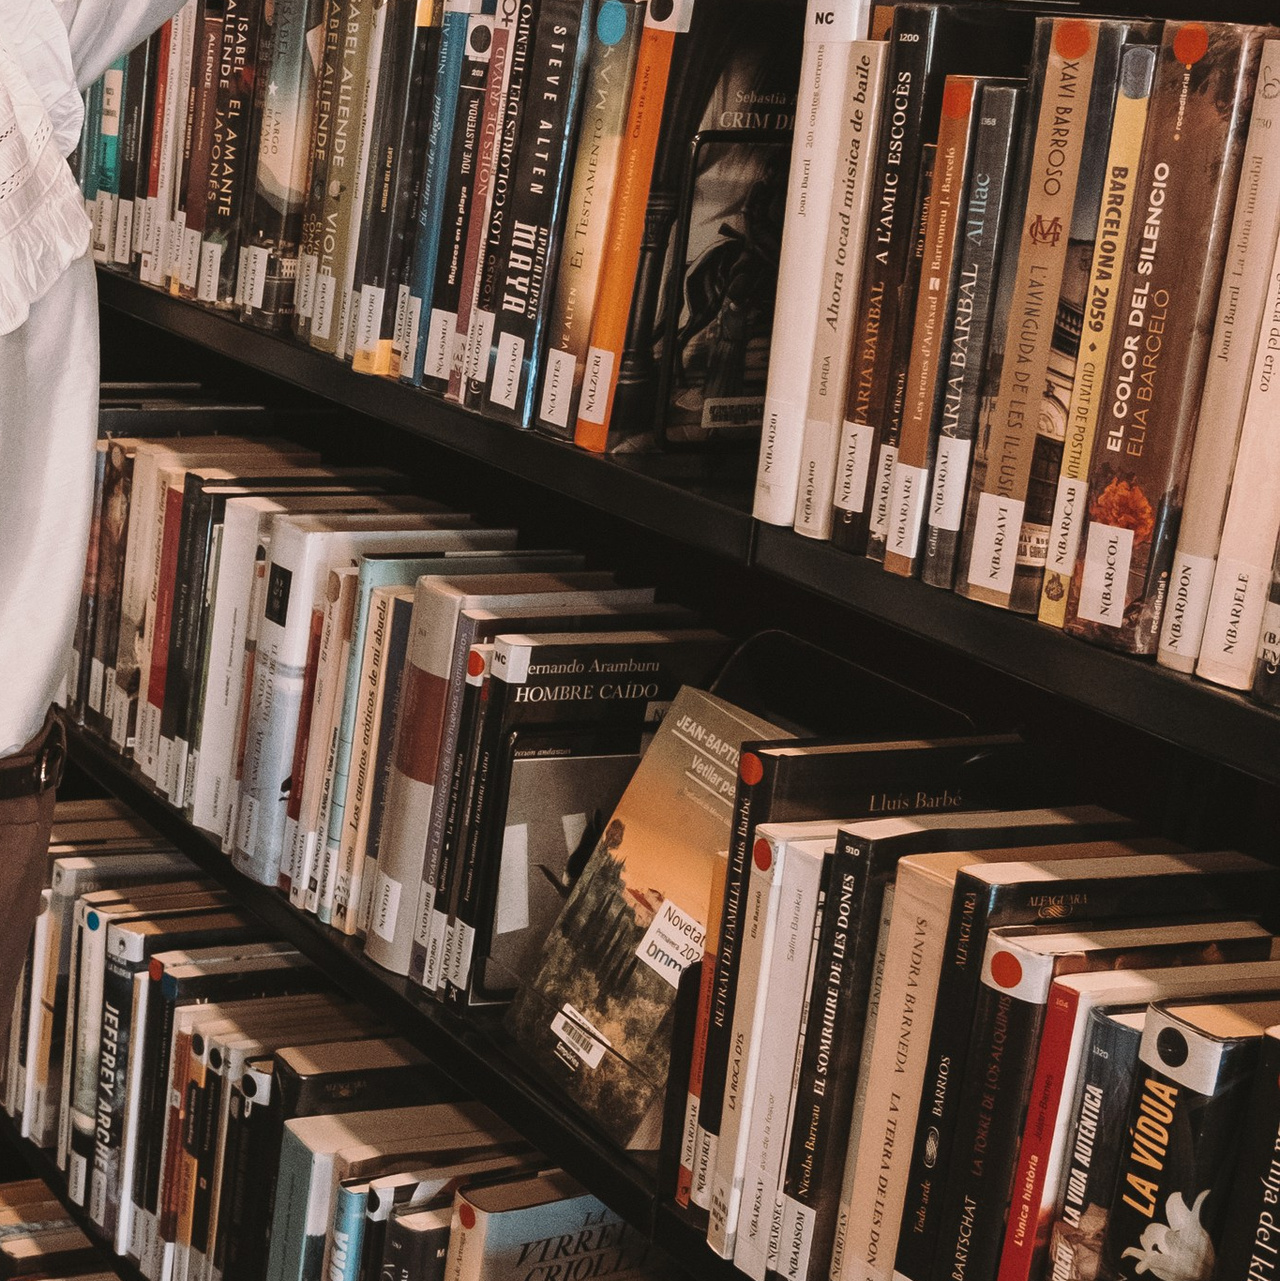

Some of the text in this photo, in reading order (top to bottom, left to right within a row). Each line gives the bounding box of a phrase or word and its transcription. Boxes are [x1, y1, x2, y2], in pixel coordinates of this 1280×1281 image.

[231, 17, 249, 75] ISABEL
[814, 11, 835, 25] NC
[314, 59, 335, 161] ALLENDE
[460, 97, 481, 175] TOVE ALSTERDAL
[489, 3, 533, 245] LOS COLORES DEL TIEMPO
[528, 24, 568, 195] STEVE ALTEN
[1042, 59, 1082, 197] XAVI BARROSO
[207, 108, 225, 201] JAPONÉS
[216, 99, 241, 217] EL AMANTE
[818, 54, 872, 397] BARBA Ahora tocad música de baile
[501, 219, 538, 315] MAYA
[525, 226, 550, 322] APOCALIPSIS
[435, 318, 449, 374] N(ALS)MUJ
[1105, 161, 1171, 453] EL COLOR DEL SILENCIO
[584, 354, 602, 413] N(ALZ)CRI
[1125, 288, 1171, 458] ELIA BARCELÓ
[762, 411, 780, 475] N(BAR)201
[839, 431, 859, 503] N(BAR)ALA
[875, 453, 894, 526] N(BAR)ARB
[894, 474, 915, 549] N(BAR)ARE
[933, 450, 951, 517] N(BAR)AL
[989, 507, 1008, 581] N(BAR)AVI
[1054, 487, 1076, 566] N(BAR)CAB
[1099, 535, 1120, 618] N(BAR)COL
[1167, 564, 1193, 649] N(BAR)DON
[1223, 573, 1250, 655] N(BAR)ELE
[493, 651, 508, 666] NC
[514, 681, 659, 704] HOMBRE CAÍDO
[525, 659, 661, 677] ernando Aramburu
[663, 905, 706, 948] Novetat
[797, 872, 856, 1198] Nicolas Barreau EL SOMRIURE DE LES DONES
[93, 1000, 120, 1173] JEFFREY ARCHE
[679, 1104, 699, 1167] N(BAR)PAR
[695, 1132, 716, 1195] N(BAR)RET
[1121, 1077, 1179, 1218] LA VÍDUA
[786, 1210, 807, 1279] N(BAR)SOM
[1254, 1211, 1279, 1246] del
